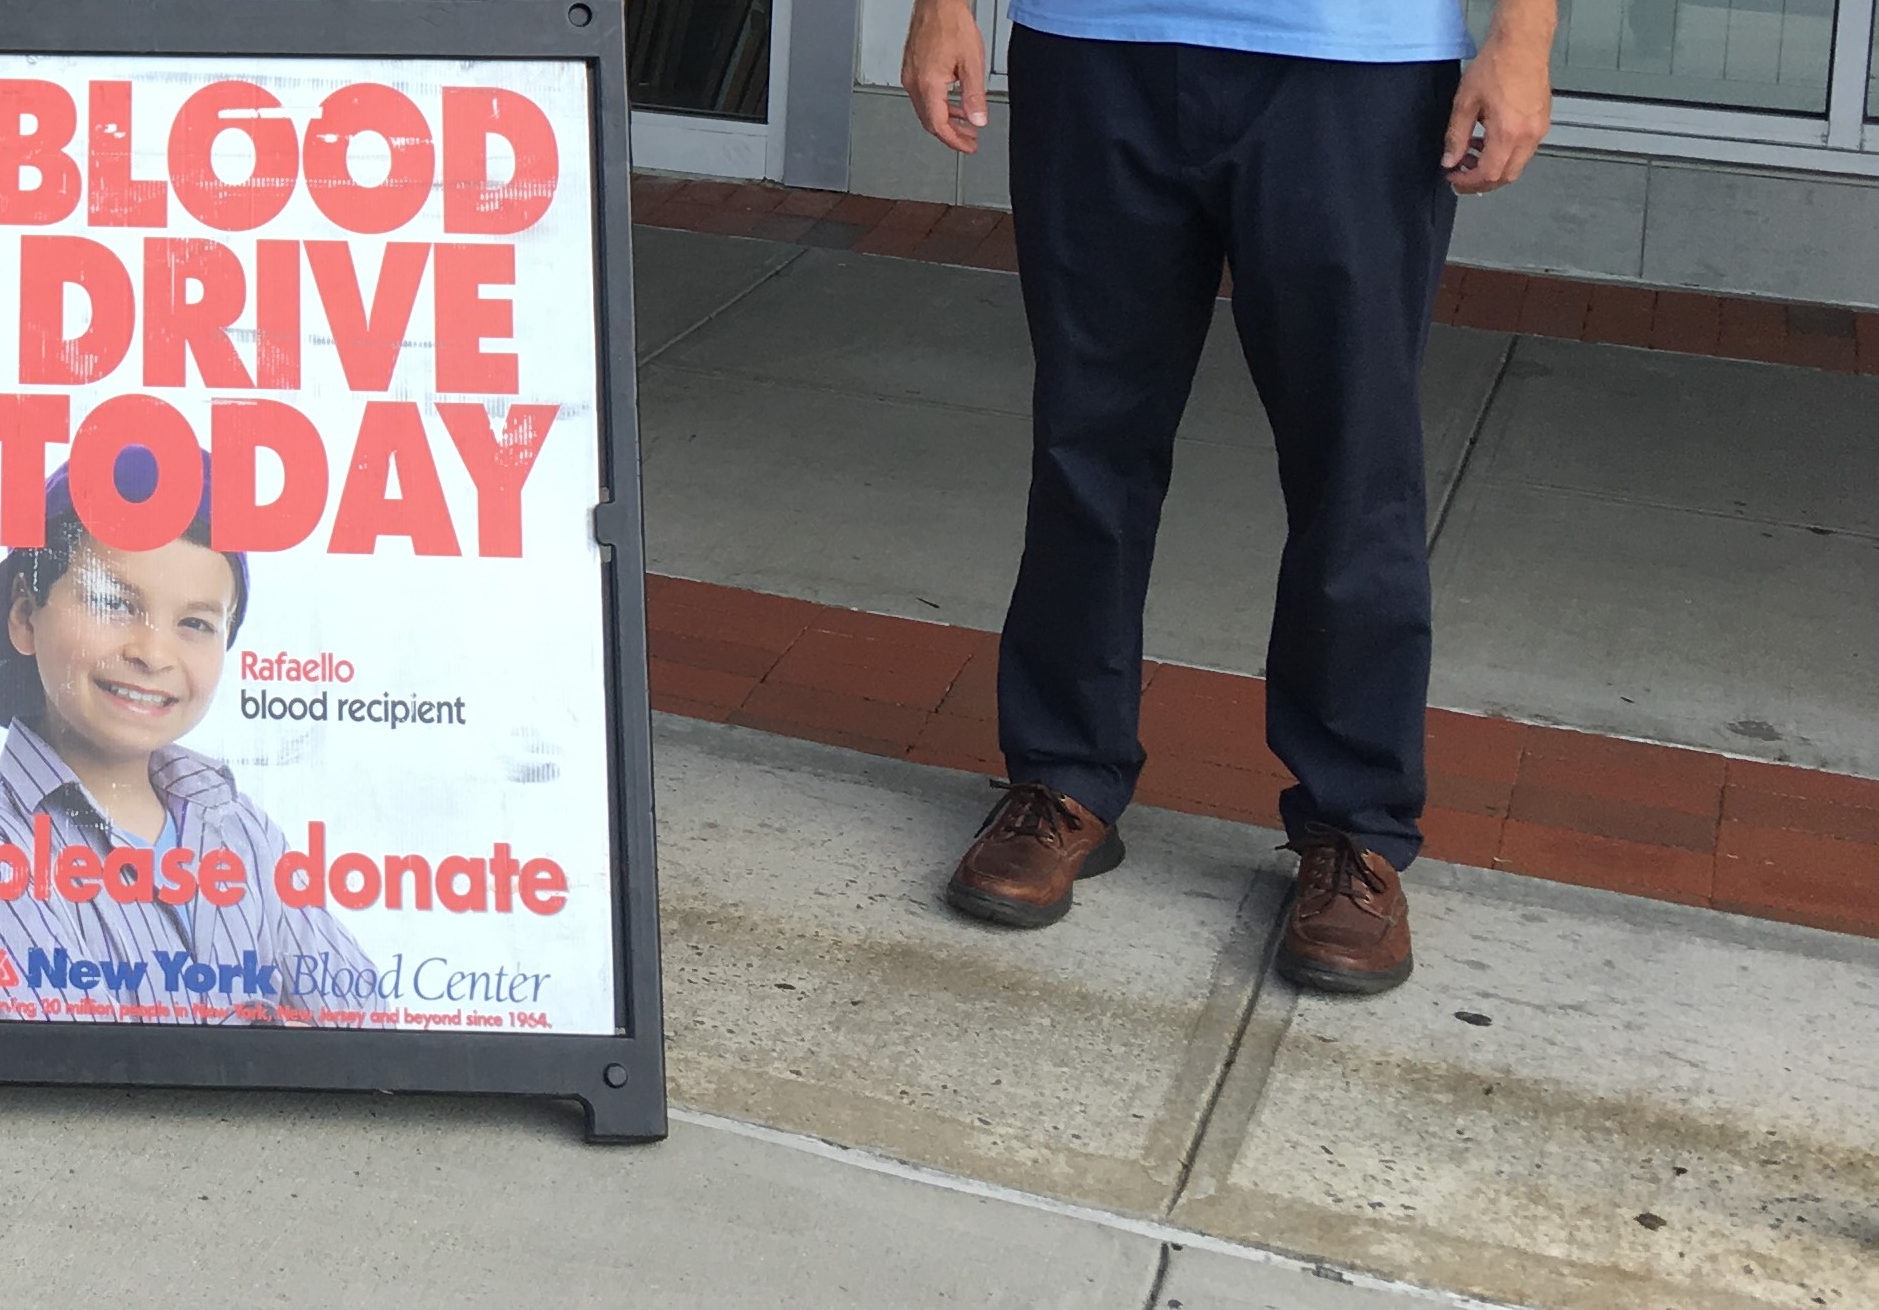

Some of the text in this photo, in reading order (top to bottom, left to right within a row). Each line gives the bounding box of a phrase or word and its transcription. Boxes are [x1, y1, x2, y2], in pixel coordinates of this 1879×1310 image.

[17, 235, 520, 395] DRIVE
[240, 651, 355, 684] Rafaello
[240, 691, 466, 730] blood recipient
[273, 821, 569, 916] donate
[26, 949, 552, 1004] New York Blood Center
[65, 998, 114, 1016] million
[118, 1002, 171, 1021] people
[175, 1001, 189, 1018] in
[193, 1001, 230, 1019] New
[234, 1002, 272, 1022] York,
[277, 1005, 314, 1022] New
[318, 1006, 365, 1028] Jersey
[369, 1007, 399, 1025] and
[404, 1008, 462, 1030] beyond
[466, 1010, 503, 1028] since
[508, 1011, 552, 1029] 1964.
